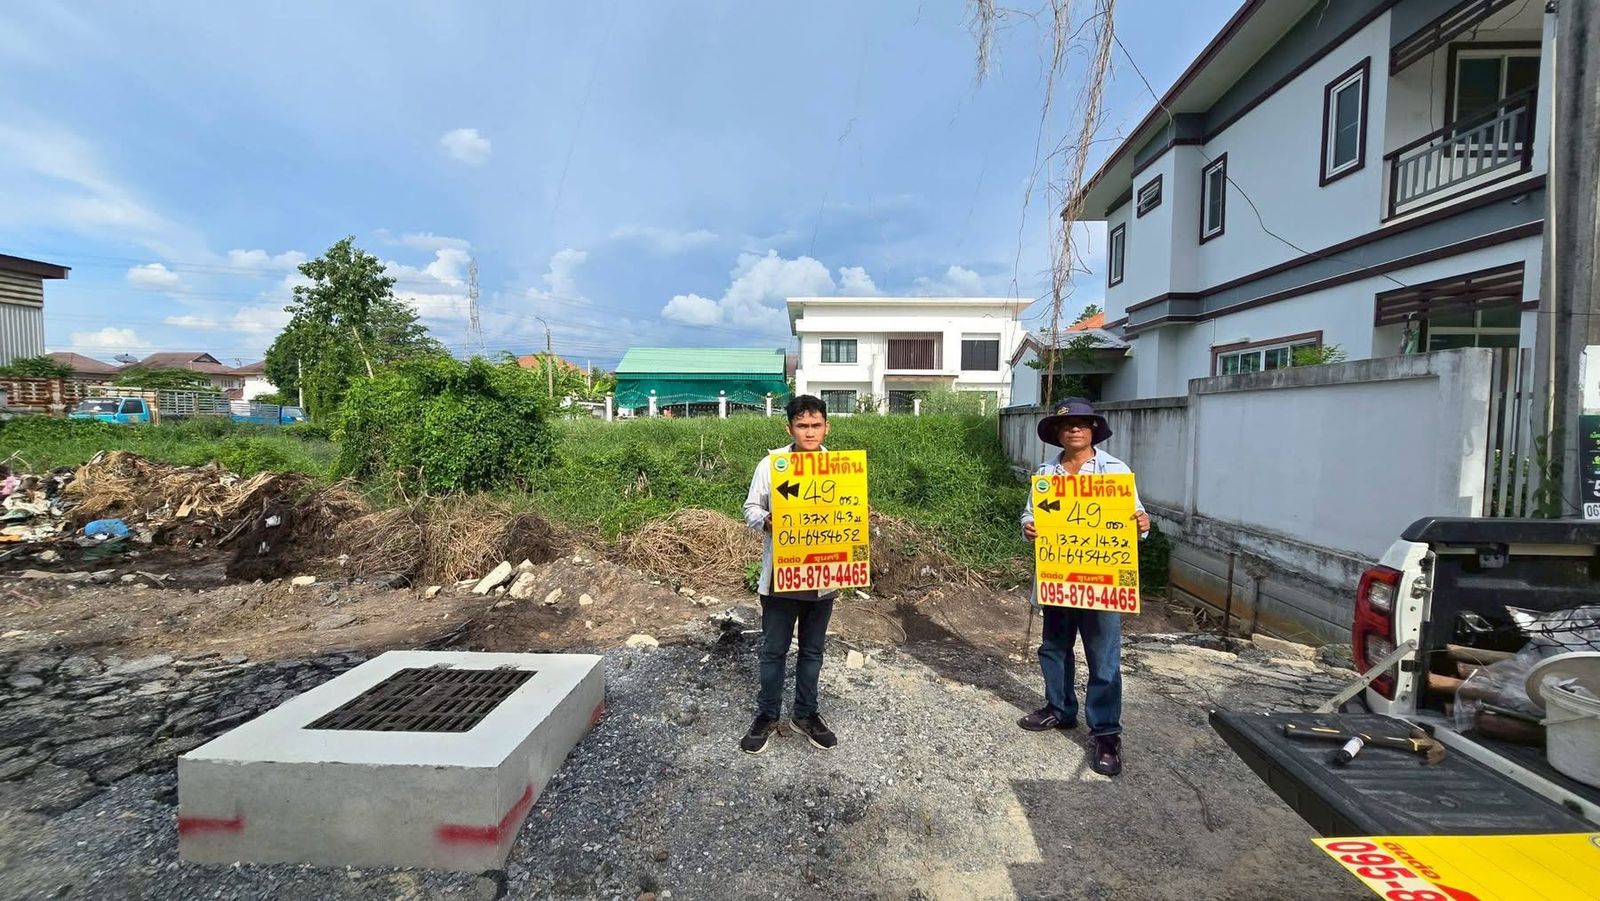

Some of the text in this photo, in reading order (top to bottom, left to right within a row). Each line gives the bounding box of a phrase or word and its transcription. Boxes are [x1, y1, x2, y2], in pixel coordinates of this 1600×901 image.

[803, 479, 837, 505] 49
[1066, 501, 1102, 528] 49
[778, 527, 861, 546] 061-6454652
[1039, 545, 1132, 566] 061-6454652
[777, 562, 868, 590] 095-879-4465
[1040, 581, 1137, 611] 095-879-4465
